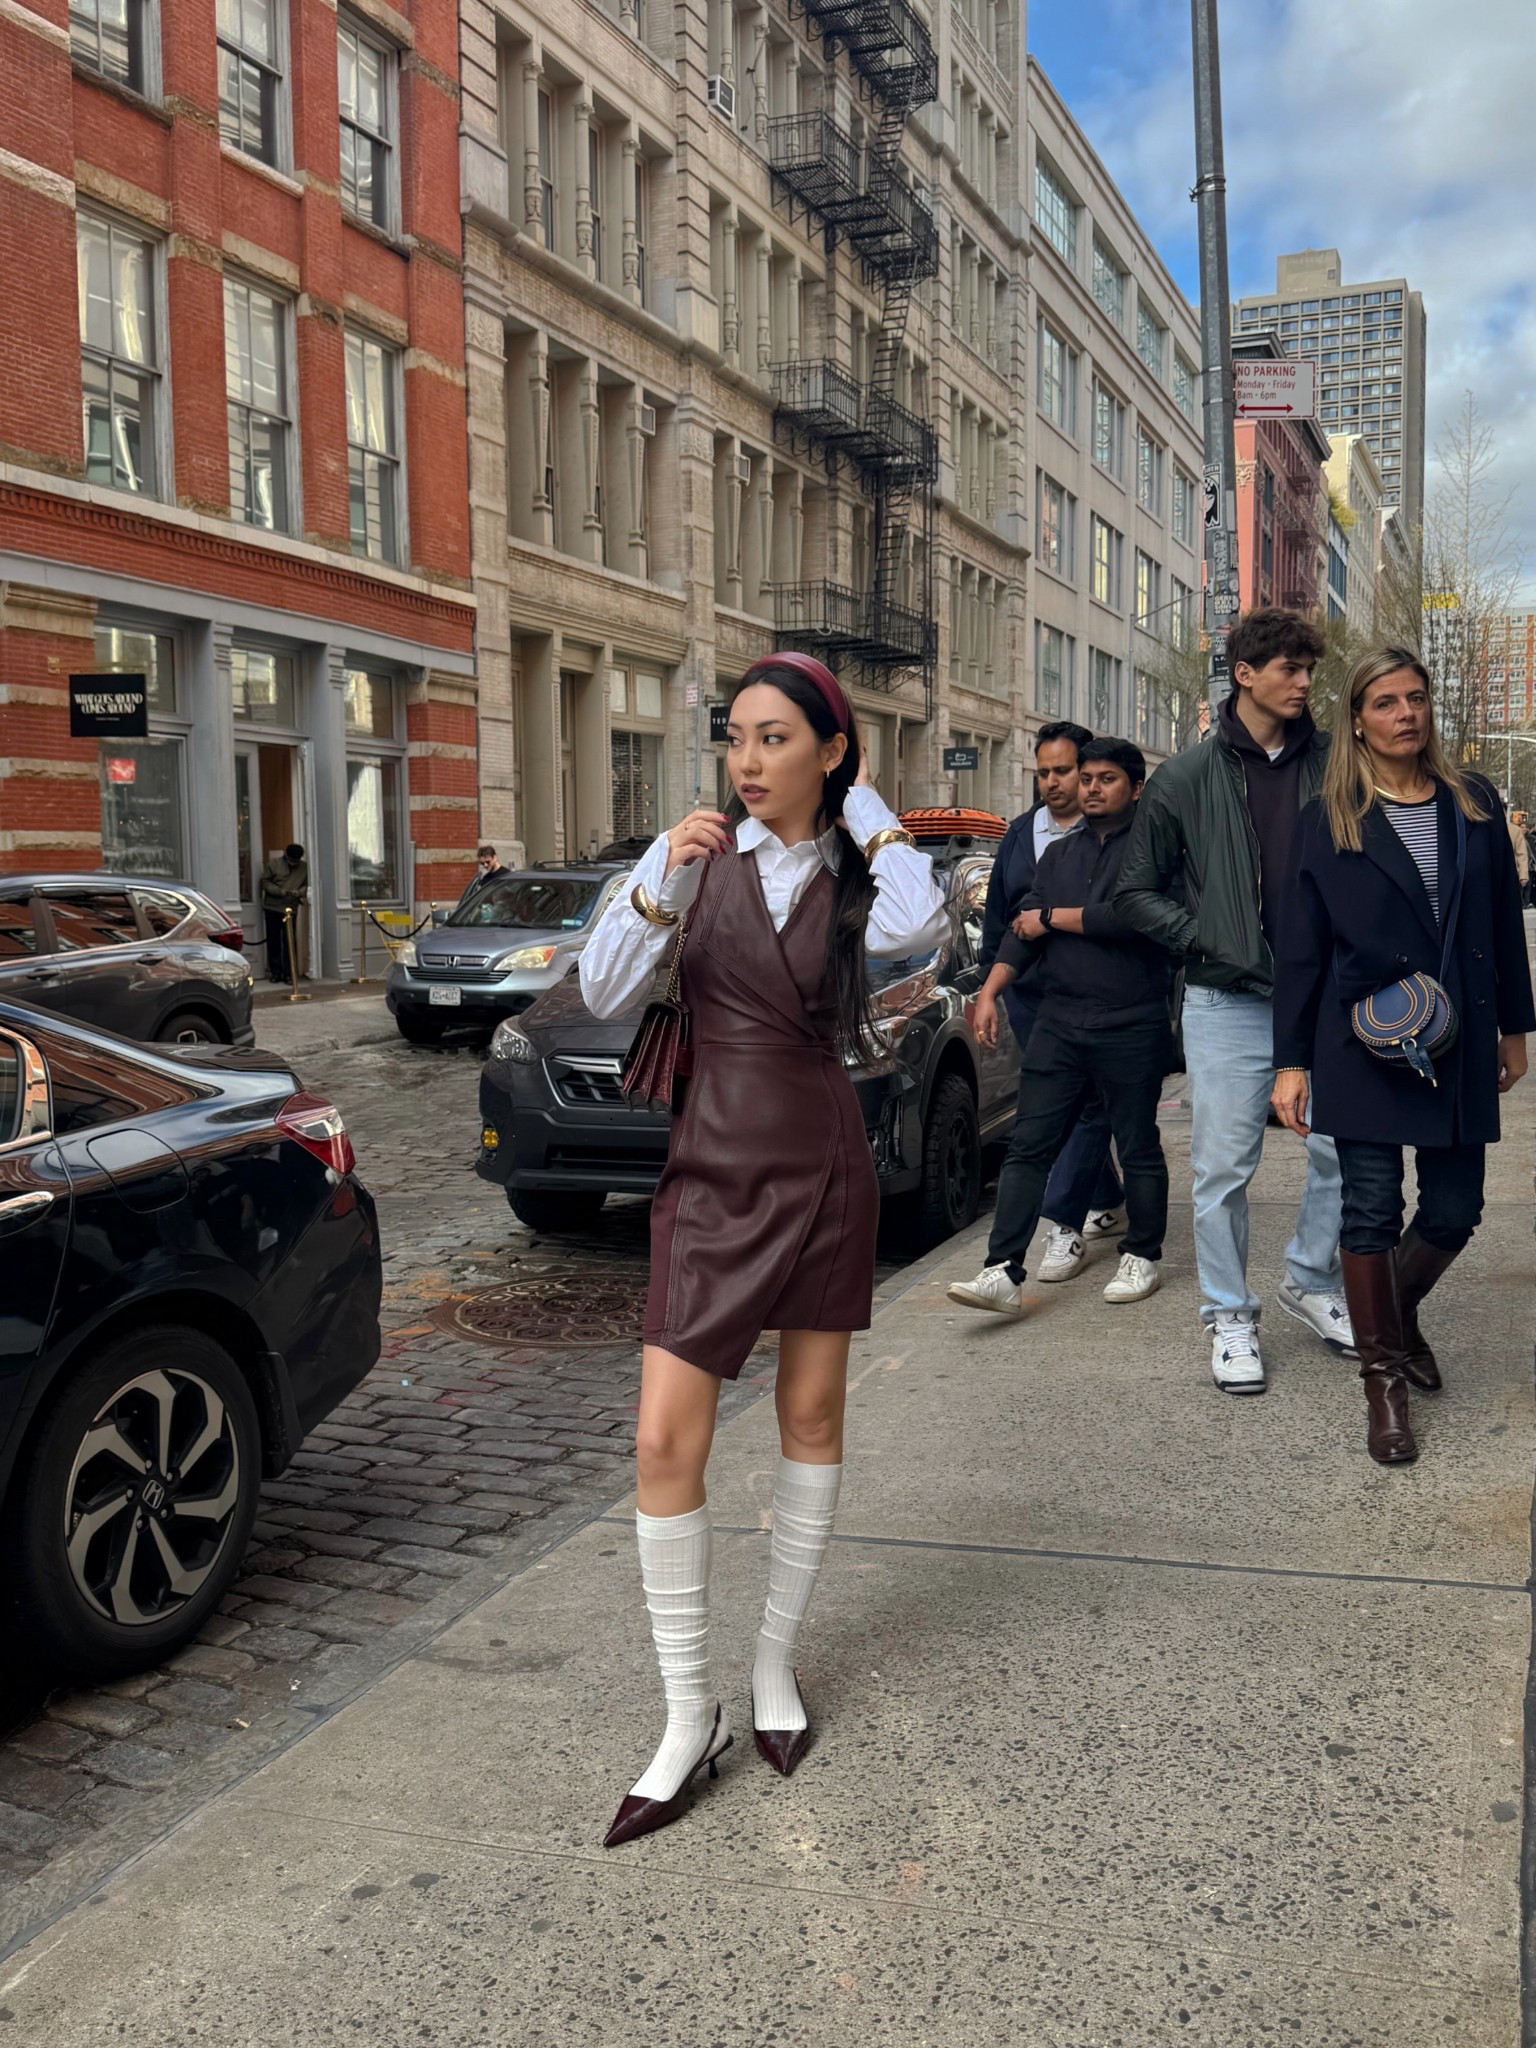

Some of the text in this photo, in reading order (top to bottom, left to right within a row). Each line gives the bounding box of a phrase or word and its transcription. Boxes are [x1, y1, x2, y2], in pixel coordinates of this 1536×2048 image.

[1237, 366, 1296, 377] NO PARKING
[1237, 380, 1265, 390] Monday
[1272, 380, 1296, 390] Friday
[1237, 391, 1253, 400] 8am
[1259, 391, 1277, 401] 6pm
